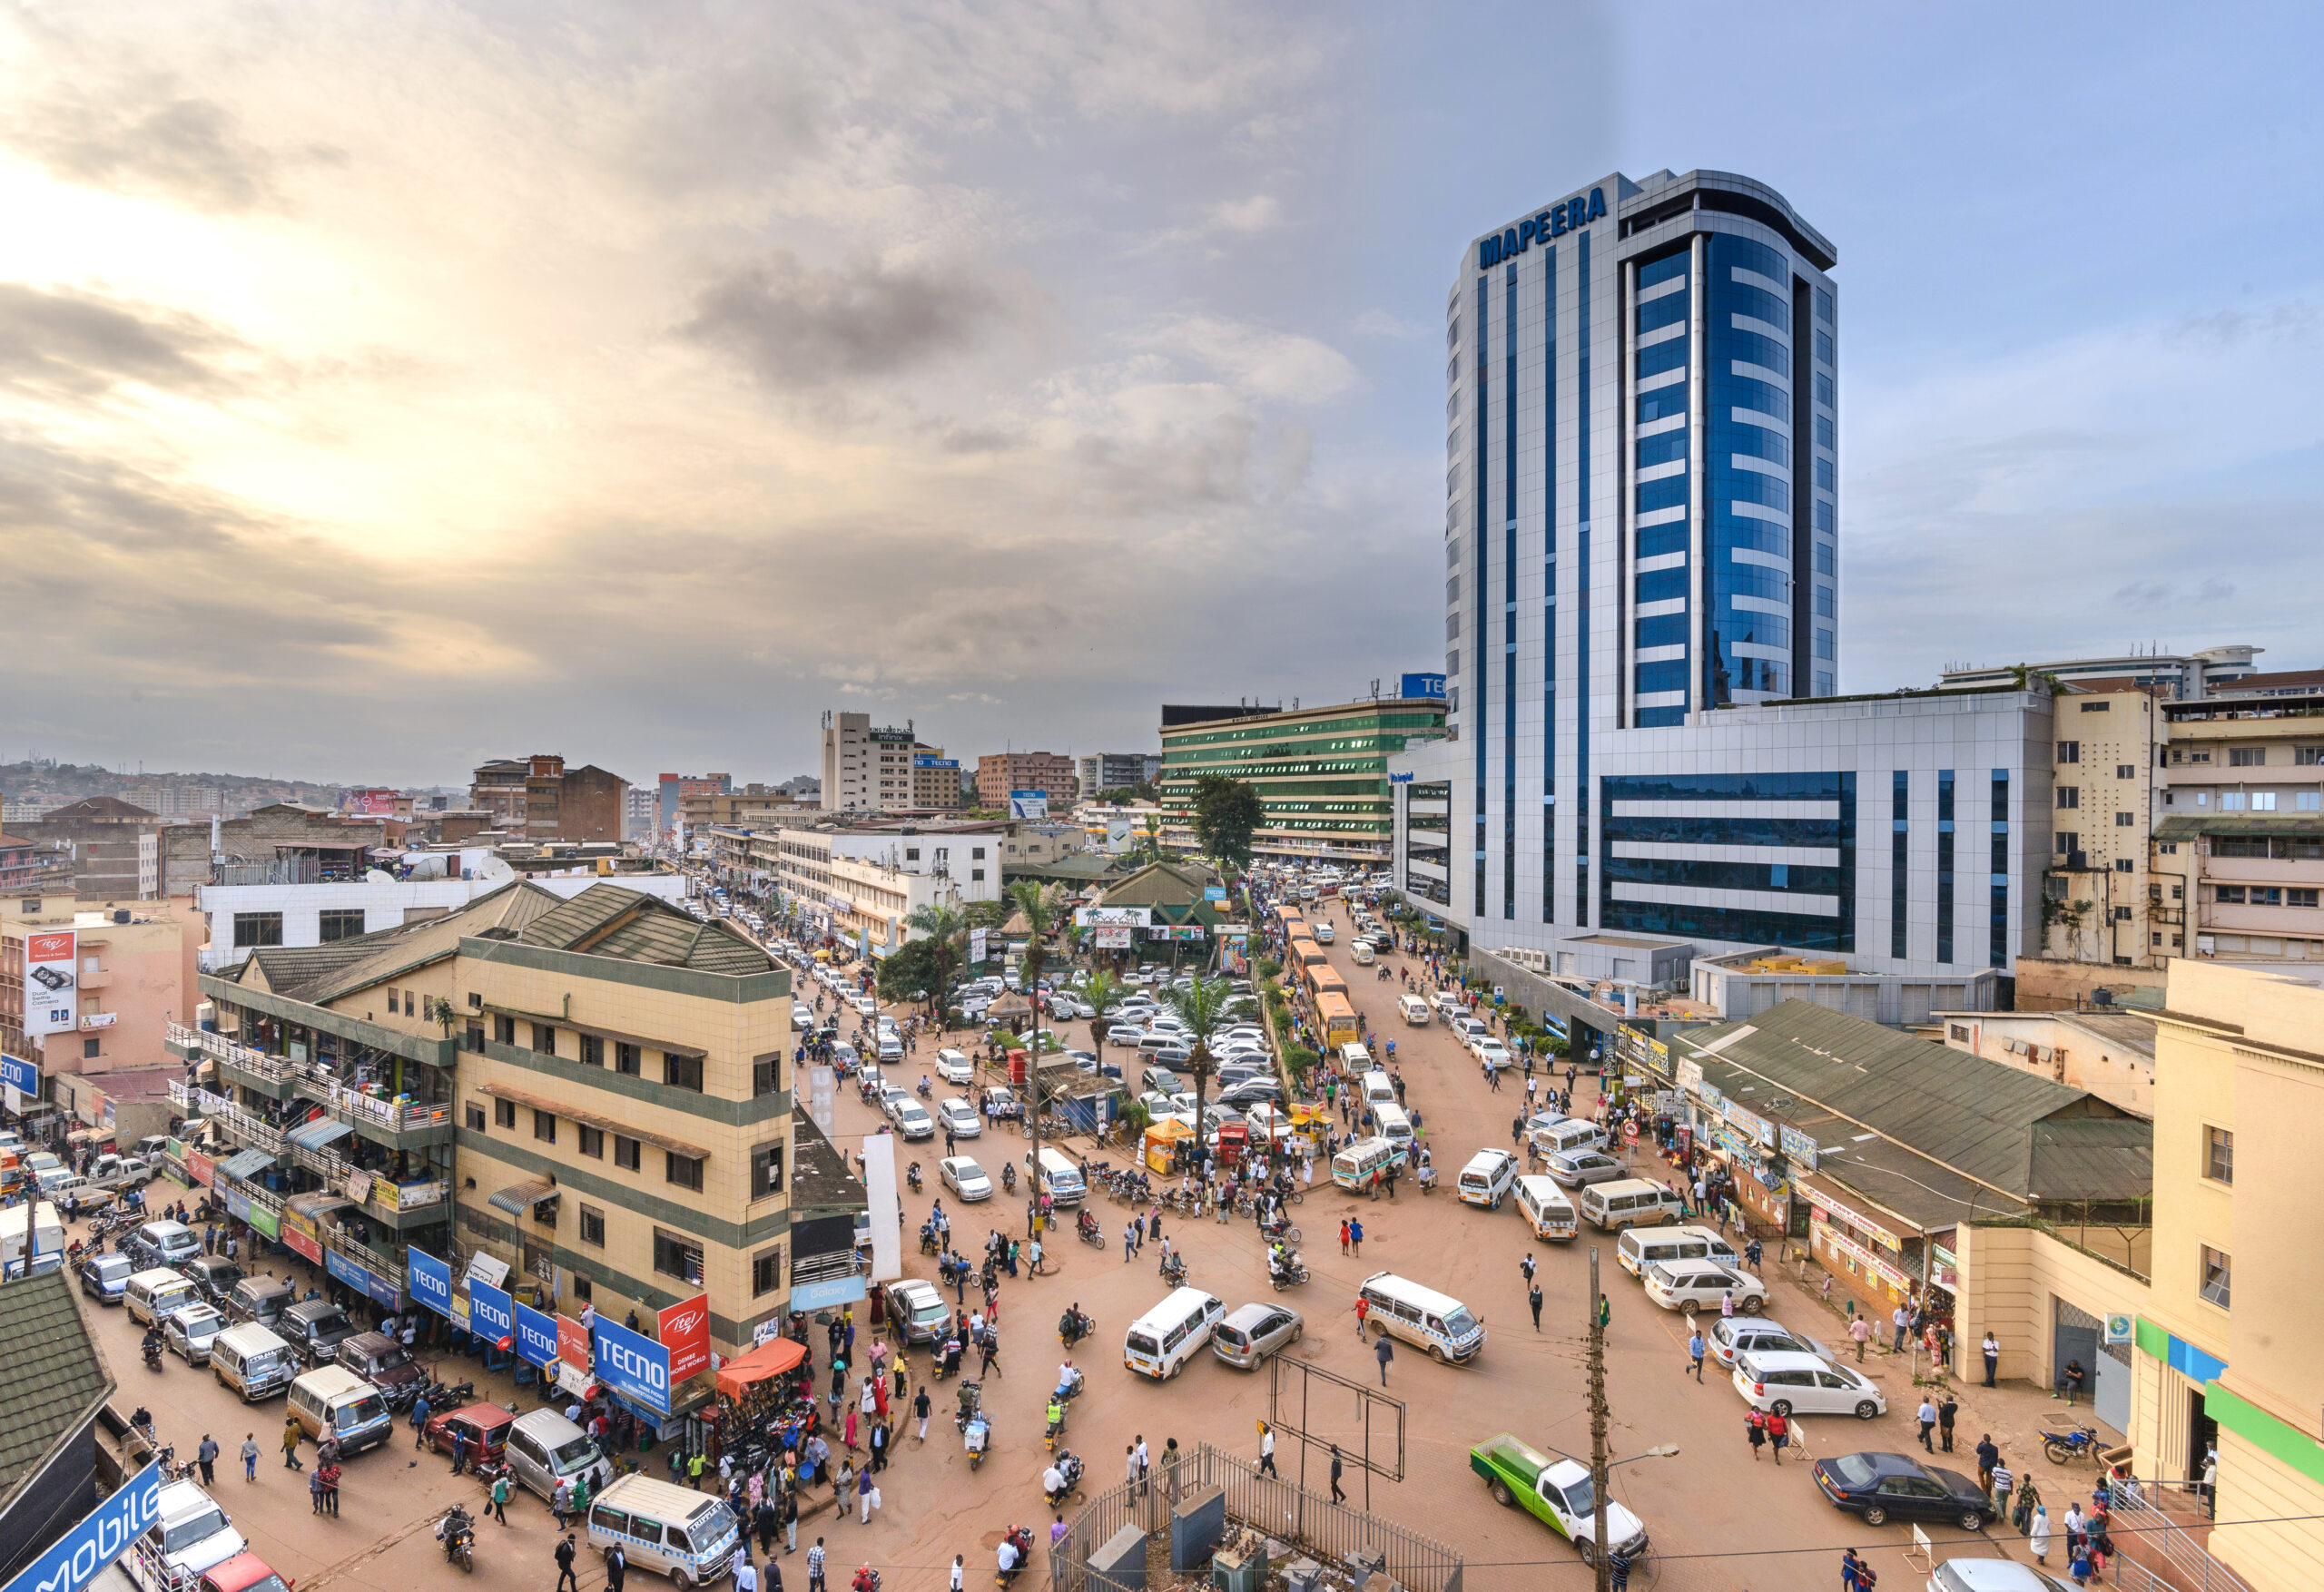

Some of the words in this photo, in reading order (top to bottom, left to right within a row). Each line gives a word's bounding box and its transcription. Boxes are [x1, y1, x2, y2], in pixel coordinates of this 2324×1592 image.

[1480, 186, 1607, 270] MAPEERA
[377, 1184, 391, 1196] PLASTIC
[1833, 1200, 1852, 1216] FAST
[1853, 1214, 1877, 1232] FOODS
[331, 1256, 347, 1272] TECNO
[1856, 1245, 1876, 1263] FAST
[1878, 1260, 1904, 1281] FOODS
[413, 1267, 447, 1297] TECNO
[810, 1284, 847, 1300] Galaxy
[473, 1297, 509, 1330] TECNO
[520, 1323, 556, 1356] TECNO
[598, 1335, 665, 1391] TECNO
[670, 1363, 686, 1377] HONE
[686, 1354, 706, 1371] WORLD
[677, 1352, 695, 1366] DEMBE
[650, 1390, 665, 1401] PHONES
[691, 1506, 717, 1532] TRIPPLE
